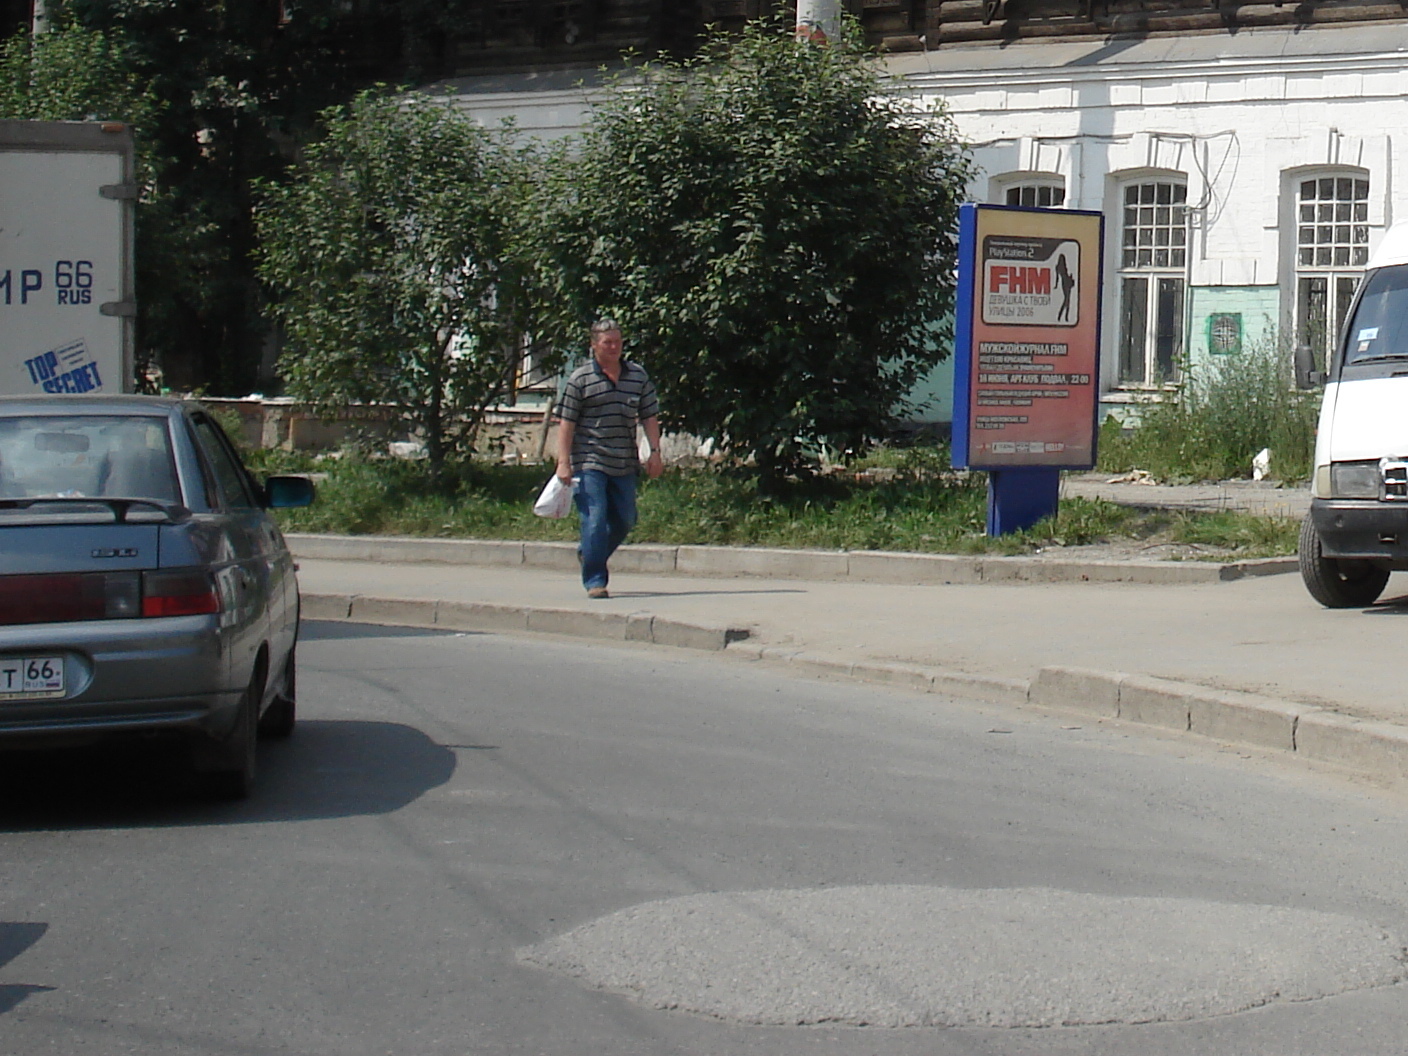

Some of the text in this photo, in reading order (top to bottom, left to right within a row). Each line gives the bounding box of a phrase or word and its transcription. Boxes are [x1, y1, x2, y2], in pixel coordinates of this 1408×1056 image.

[55, 260, 94, 289] 66
[989, 266, 1051, 295] FHM
[58, 289, 92, 305] RUS
[24, 350, 58, 385] TOP
[27, 660, 54, 680] 66
